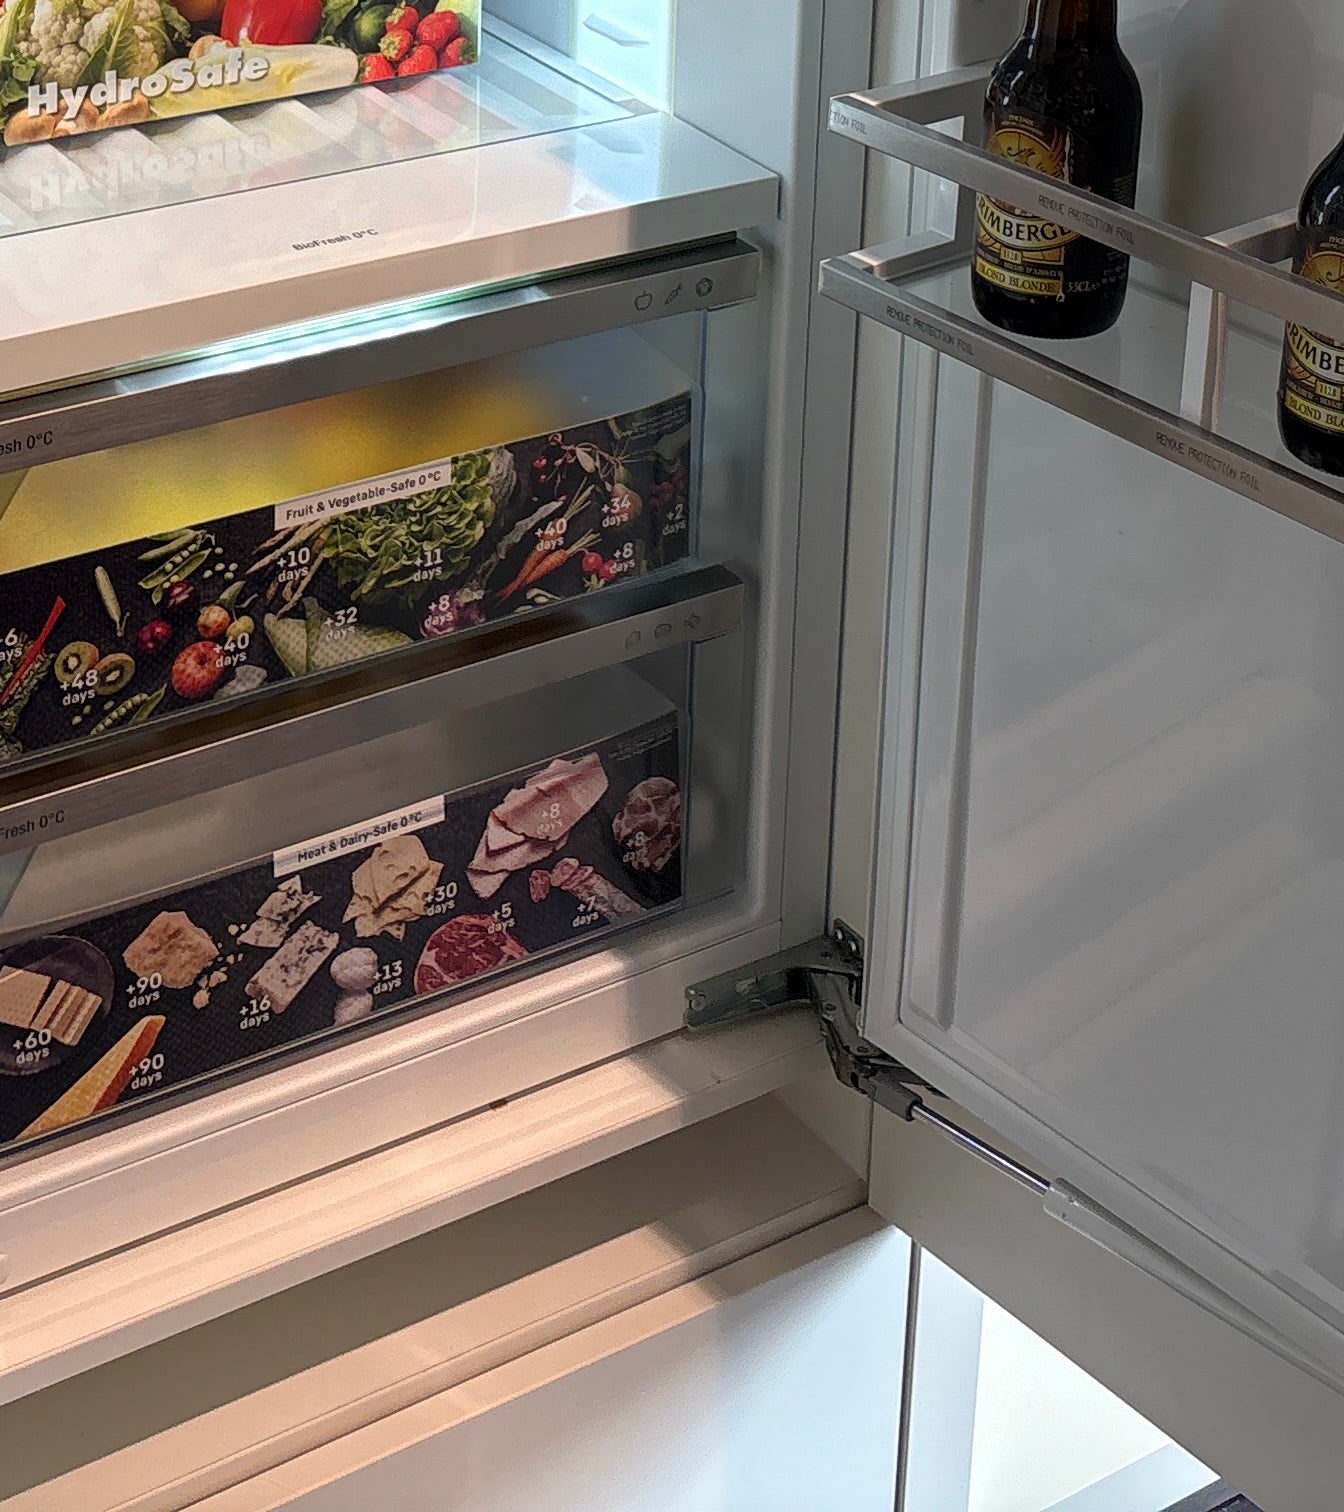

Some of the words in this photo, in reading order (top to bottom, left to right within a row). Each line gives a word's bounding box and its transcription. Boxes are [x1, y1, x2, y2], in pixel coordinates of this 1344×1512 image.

[27, 47, 270, 120] HydroSafe
[292, 234, 352, 251] BioFresh
[352, 228, 379, 239] 0°C
[1008, 275, 1057, 294] BLONDE
[1289, 395, 1322, 421] BLOND
[26, 430, 54, 450] 0°C
[1187, 446, 1236, 480] PROTECTION
[285, 504, 314, 521] Fruit
[316, 501, 325, 514] &
[327, 478, 416, 509] Vegetable-Safe
[601, 493, 631, 514] +34
[601, 511, 629, 528] days
[666, 503, 685, 521] +2
[534, 517, 567, 538] +40
[662, 519, 687, 536] days
[536, 536, 565, 552] days
[613, 541, 634, 560] +8
[276, 546, 311, 569] +10
[414, 547, 444, 568] +11
[609, 558, 636, 575] days
[277, 566, 309, 583] days
[413, 566, 443, 582] days
[427, 594, 451, 613] +8
[323, 606, 358, 628] +32
[423, 611, 454, 629] days
[212, 632, 250, 654] +40
[215, 651, 247, 668] days
[59, 669, 98, 692] +48
[62, 688, 96, 706] days
[39, 809, 65, 829] 0°C
[541, 802, 562, 819] +8
[297, 845, 326, 863] Meat
[328, 840, 338, 852] &
[339, 821, 398, 849] Dairy-Safe
[425, 881, 458, 904] +30
[426, 899, 456, 917] days
[492, 901, 513, 921] +5
[576, 895, 596, 914] +7
[487, 917, 516, 935] days
[572, 910, 600, 928] days
[373, 959, 404, 982] +13
[125, 972, 163, 995] +90
[372, 977, 402, 996] days
[128, 990, 161, 1009] days
[239, 994, 272, 1016] +16
[239, 1012, 270, 1030] days
[12, 1028, 52, 1052] +60
[15, 1046, 51, 1065] days
[129, 1053, 165, 1077] +90
[131, 1071, 163, 1090] days
